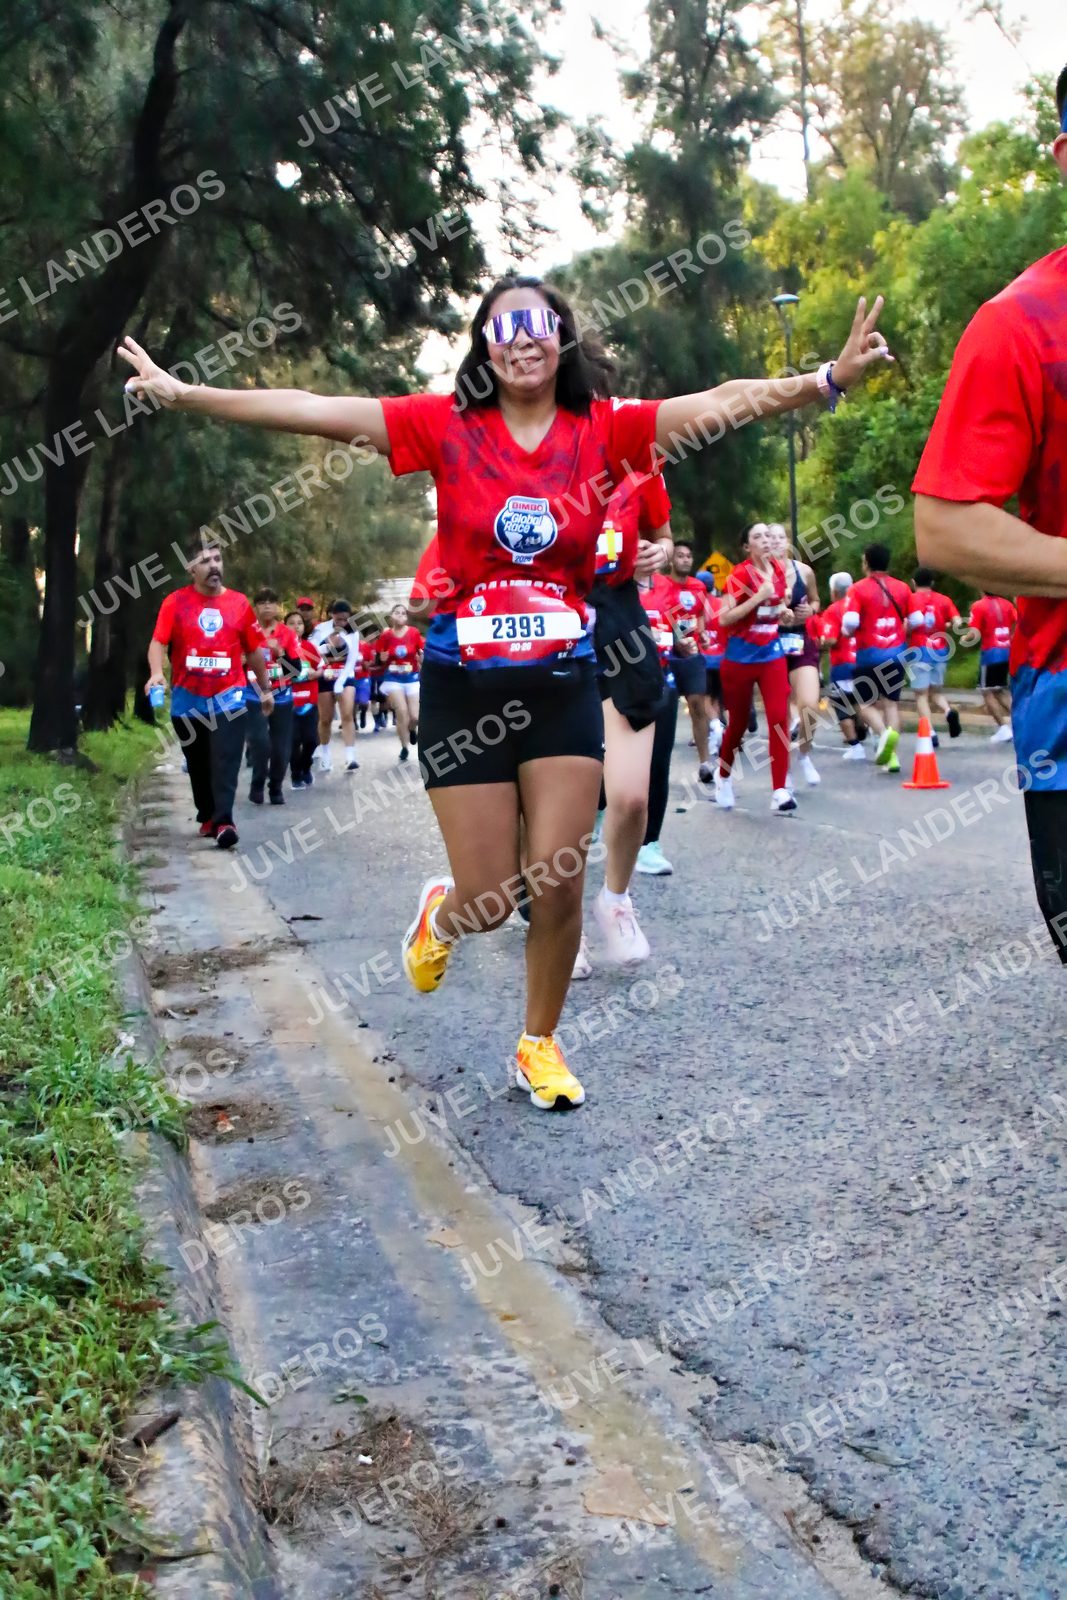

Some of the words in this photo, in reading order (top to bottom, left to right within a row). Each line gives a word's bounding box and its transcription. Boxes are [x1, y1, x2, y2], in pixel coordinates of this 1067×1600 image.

[511, 502, 544, 512] BIMBO
[511, 513, 543, 526] Global
[503, 522, 530, 533] Race
[491, 615, 546, 639] 2393
[199, 658, 217, 667] 2281
